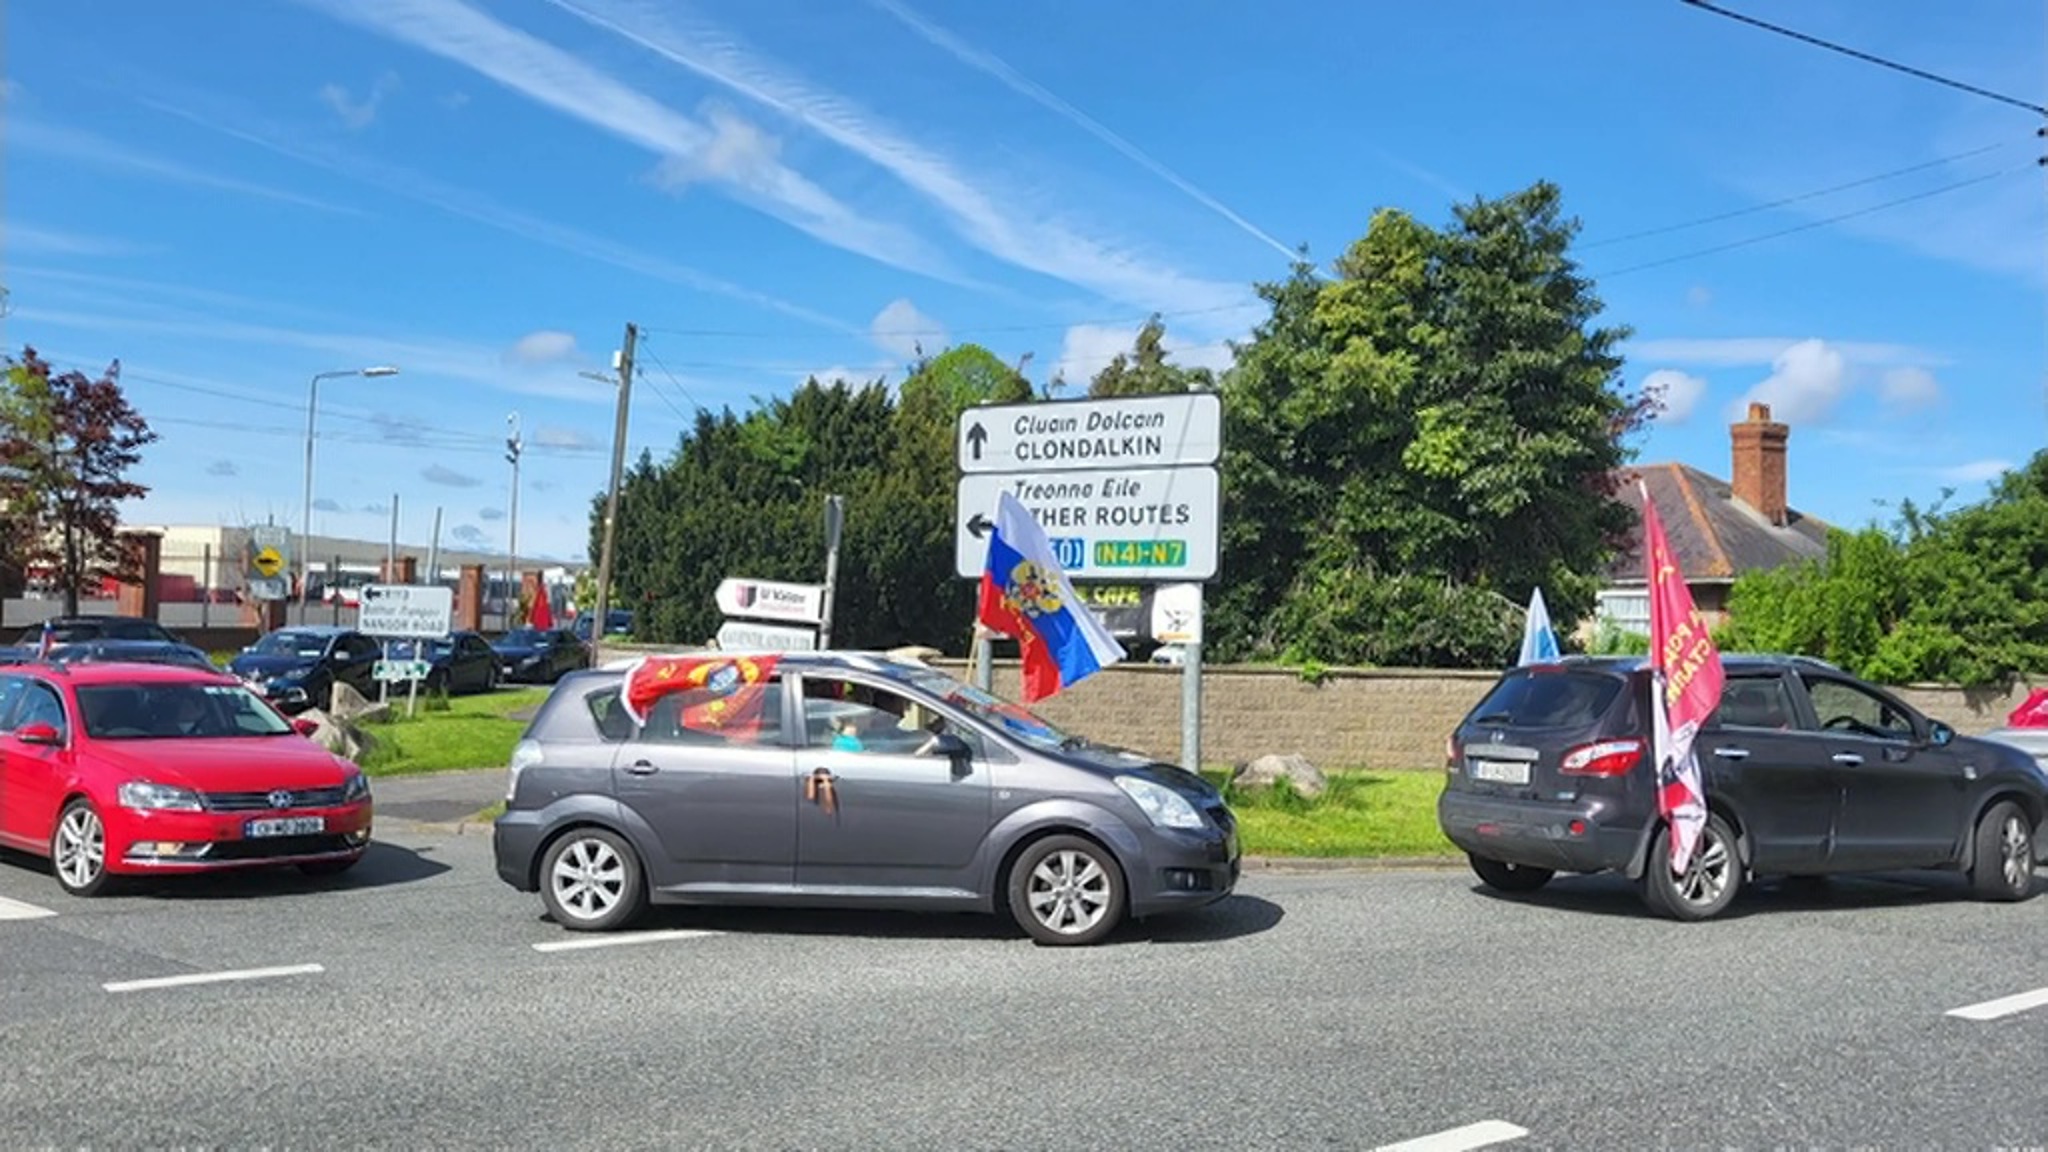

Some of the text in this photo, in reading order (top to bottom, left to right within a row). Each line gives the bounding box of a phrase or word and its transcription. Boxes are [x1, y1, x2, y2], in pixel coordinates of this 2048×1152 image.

[1014, 411, 1165, 436] Cluain Dolcain
[1015, 435, 1162, 462] CLONDALKIN
[1014, 478, 1141, 501] Treonna Eile
[1029, 503, 1190, 527] THER ROUTES
[413, 619, 445, 632] ROAD
